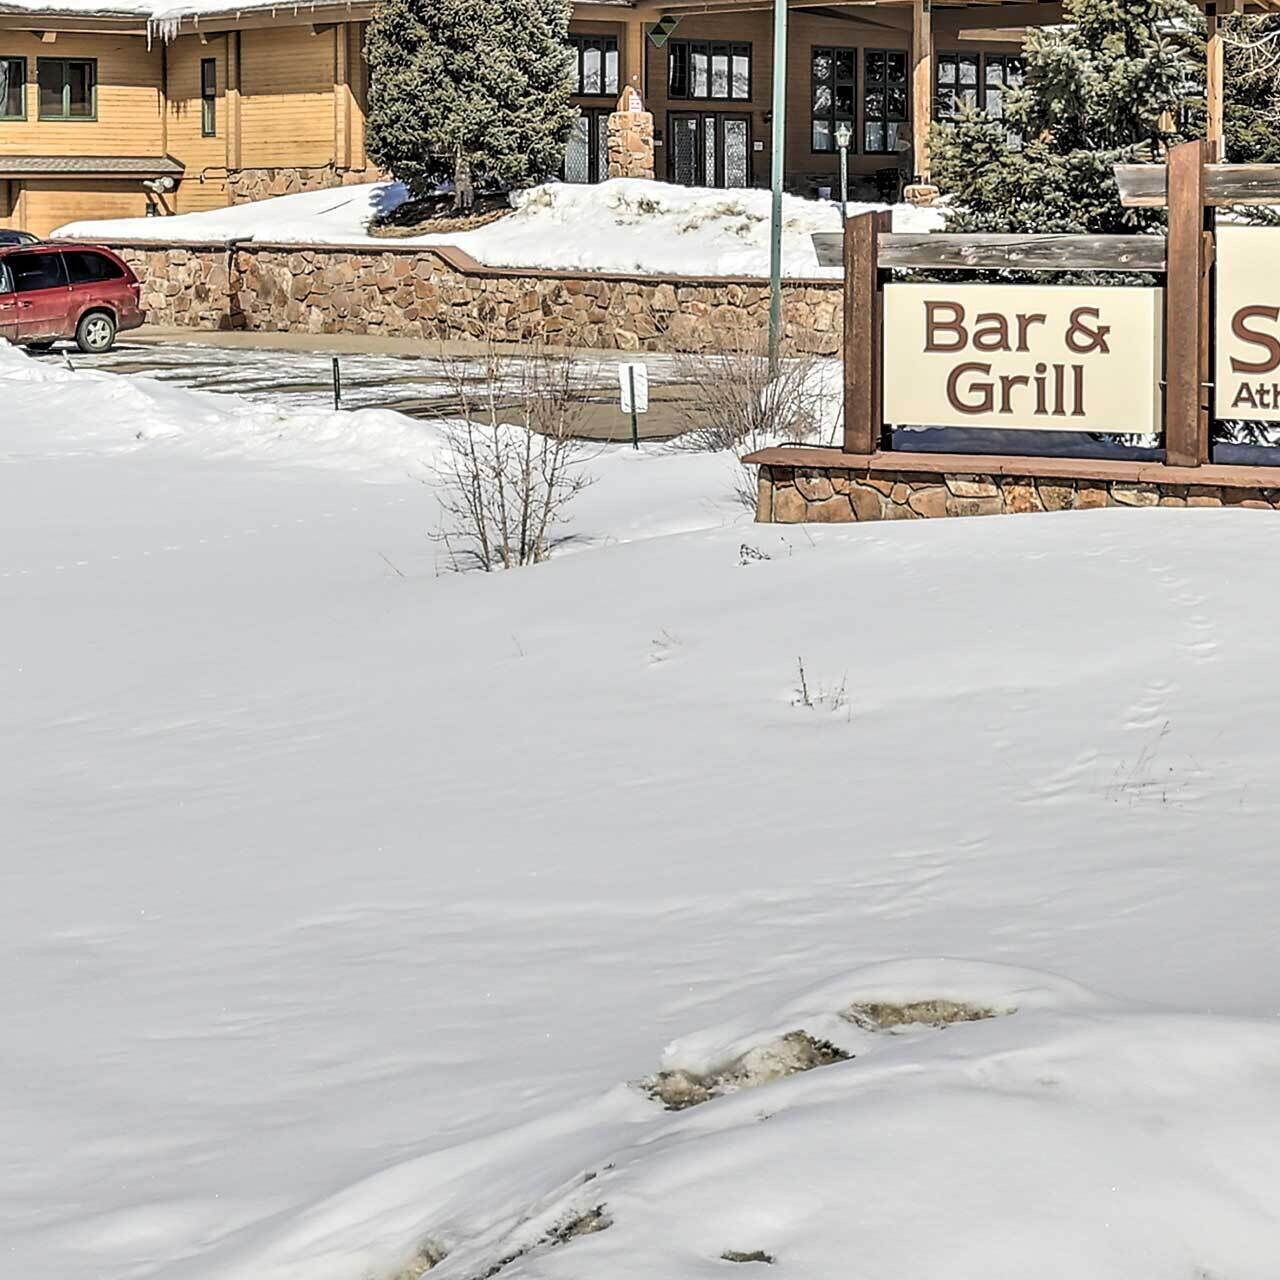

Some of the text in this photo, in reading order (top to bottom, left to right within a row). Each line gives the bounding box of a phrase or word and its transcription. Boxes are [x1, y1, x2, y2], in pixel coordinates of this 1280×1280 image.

[924, 301, 1110, 354] Bar &
[947, 362, 1085, 416] Grill
